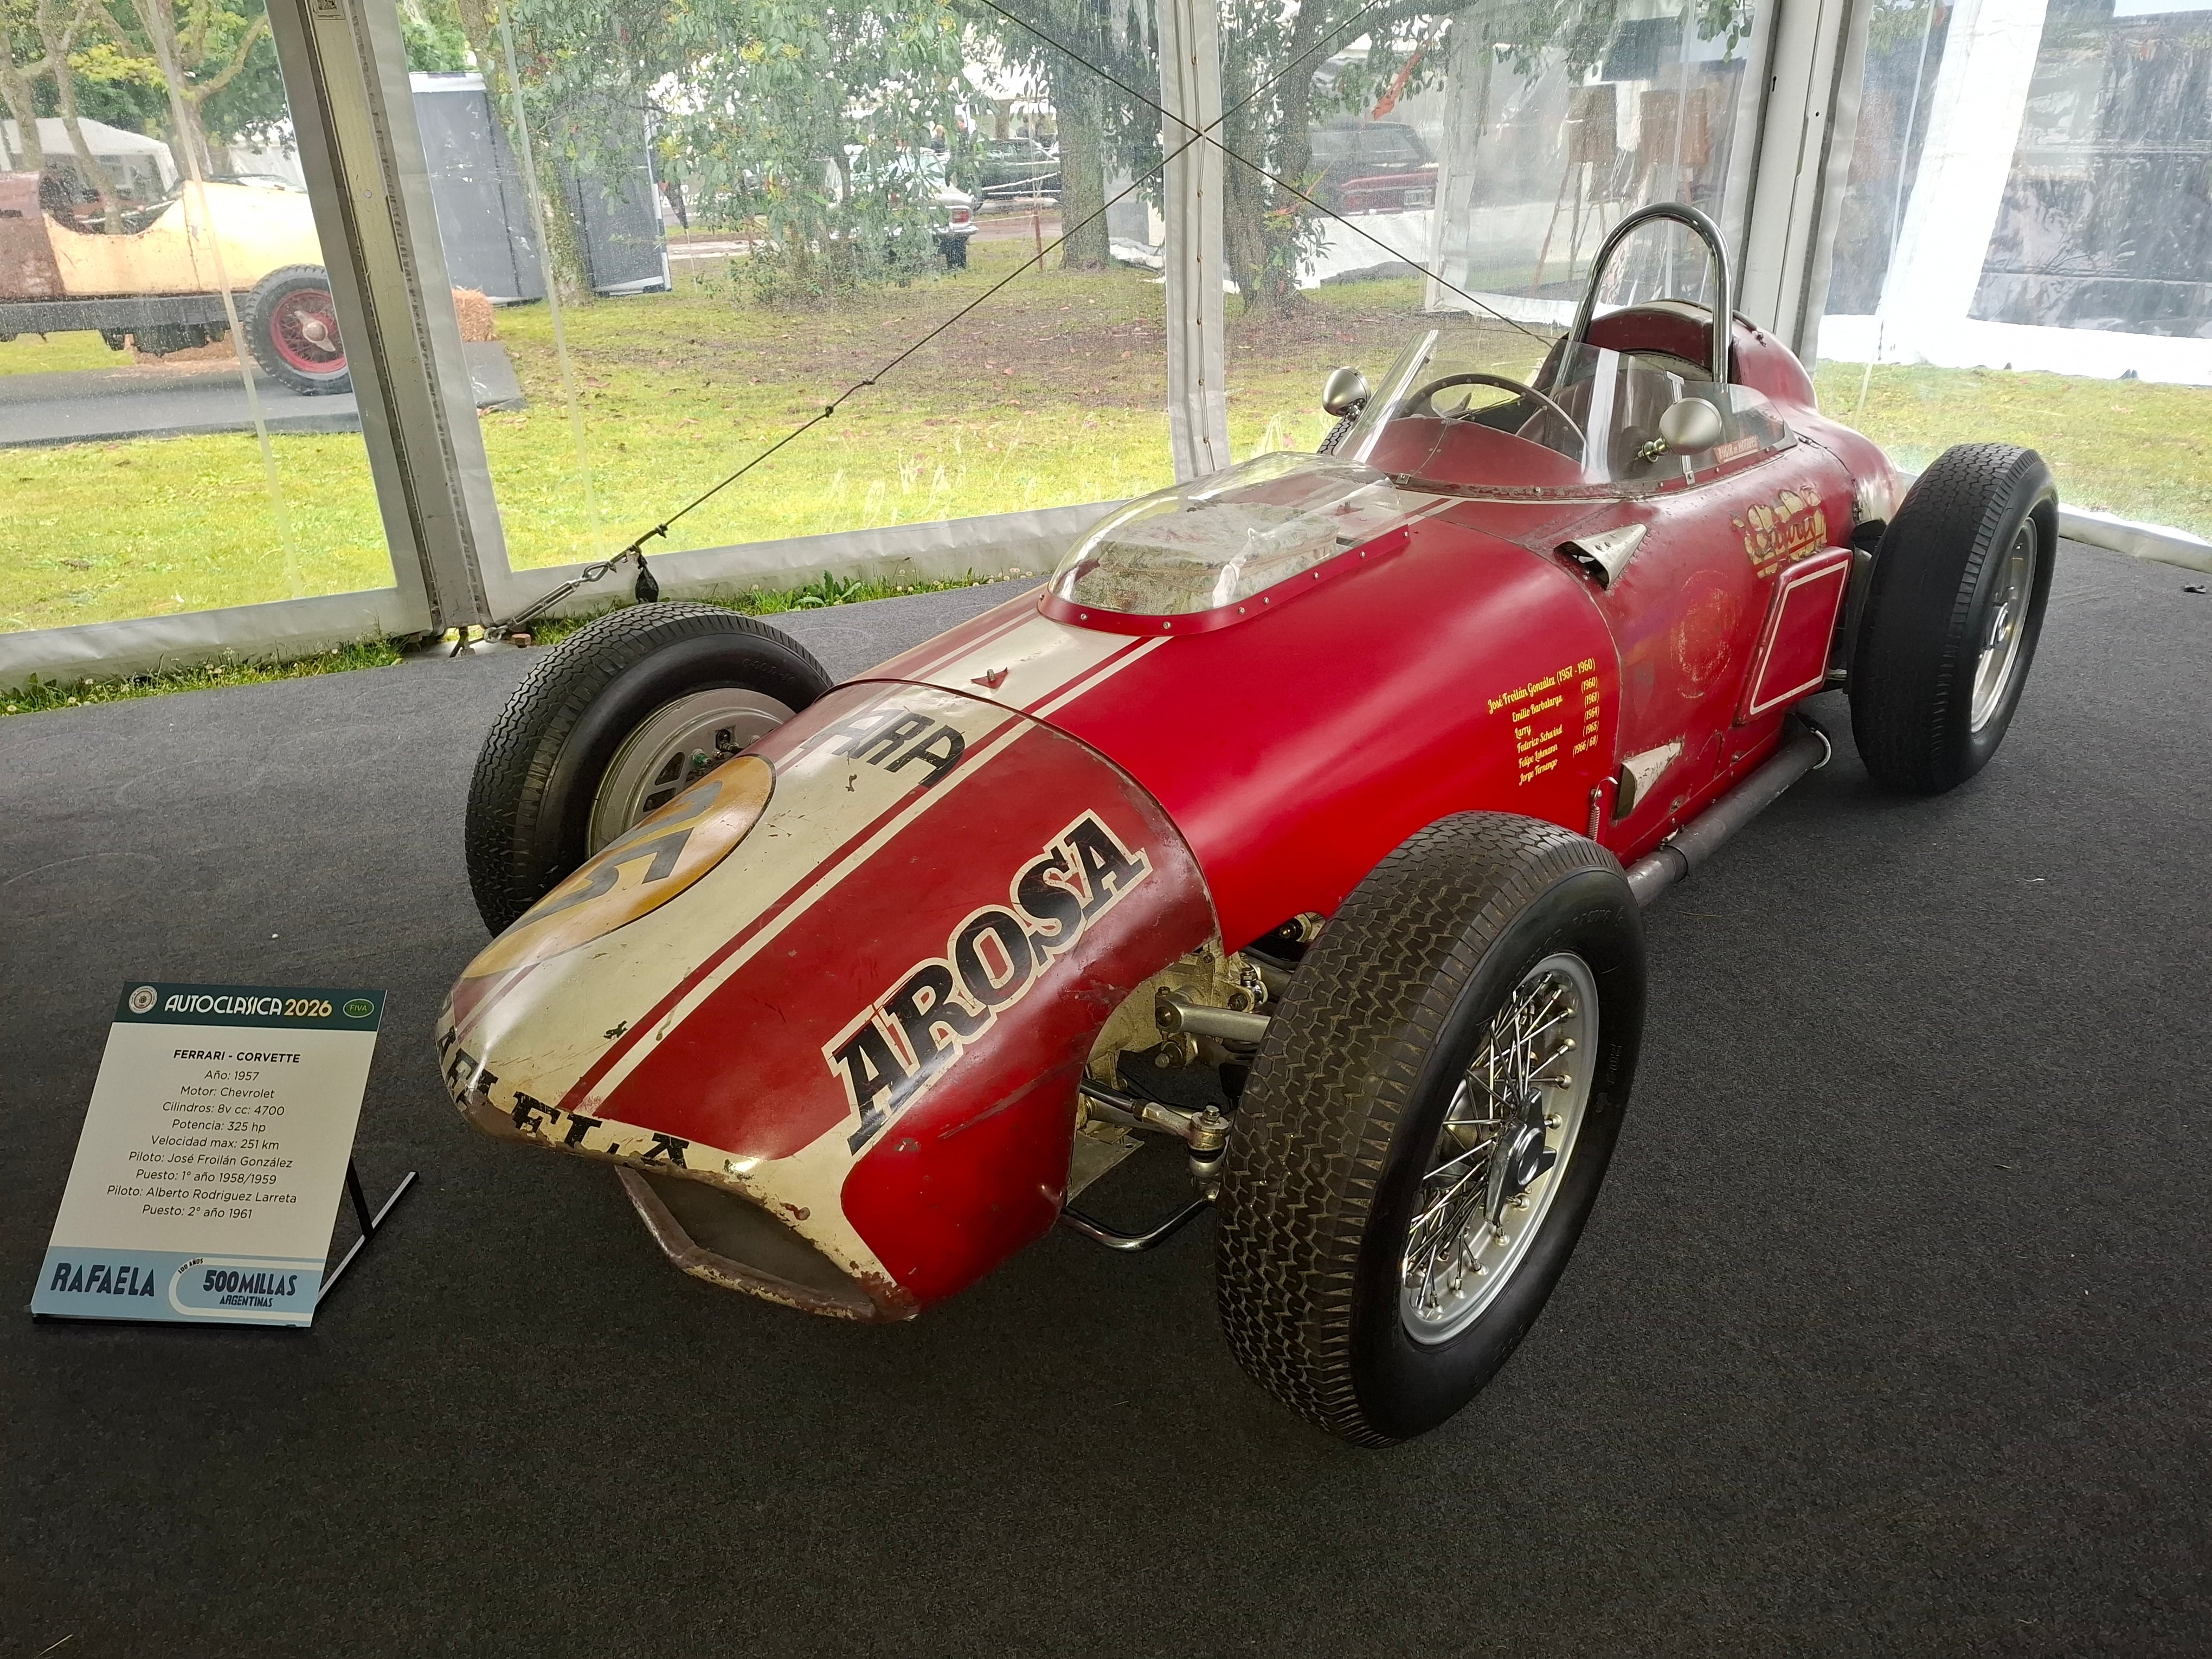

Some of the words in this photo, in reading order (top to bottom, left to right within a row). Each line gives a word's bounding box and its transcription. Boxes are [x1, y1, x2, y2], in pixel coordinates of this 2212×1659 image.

[1488, 695, 1503, 715] José
[1502, 686, 1528, 705] Froilán
[1527, 676, 1555, 697] González
[1557, 665, 1573, 686] (1957
[1577, 657, 1596, 674] 1960)
[1512, 708, 1531, 722] Emilio
[1530, 695, 1563, 715] Barbalarga
[1581, 676, 1598, 694] (1960)
[1514, 725, 1532, 740] Larry
[1584, 690, 1599, 709] (1961)
[1517, 737, 1540, 754] Federico
[1540, 724, 1562, 743] Schwind
[1584, 705, 1600, 723] (1964)
[1518, 755, 1534, 769] Felipe
[1534, 744, 1558, 762] Lehmann
[1519, 770, 1534, 786] Jorge
[1534, 758, 1558, 776] Ternengo
[826, 812, 1149, 1159] AROSA
[283, 998, 333, 1017] 2026
[349, 1004, 368, 1012] FIVA
[173, 1049, 226, 1060] FERRARI
[236, 1052, 301, 1063] CORVETTE
[204, 1070, 231, 1080] Año:
[234, 1071, 260, 1081] 1957
[180, 1085, 217, 1096] Motor:
[220, 1087, 275, 1098] Chevrolet
[163, 1101, 215, 1113] Cilindros:
[217, 1103, 232, 1114] 8v
[235, 1107, 251, 1115] cc:
[254, 1105, 285, 1116] 4700
[172, 1118, 224, 1130] Potencia:
[227, 1121, 249, 1131] 325
[251, 1122, 266, 1134] hp
[152, 1135, 208, 1147] Velocidad
[210, 1140, 237, 1148] max:
[240, 1139, 259, 1149] 251
[261, 1139, 279, 1150] km
[128, 1151, 165, 1162] Piloto:
[167, 1153, 194, 1163] José
[197, 1154, 236, 1166] Froilán
[240, 1156, 293, 1168] González
[136, 1168, 178, 1180] Puesto:
[194, 1172, 215, 1182] año
[219, 1172, 276, 1185] 1958/1959
[107, 1185, 143, 1197] Piloto:
[145, 1186, 189, 1198] Alberto
[255, 1192, 297, 1204] Larreta
[142, 1204, 185, 1216] Puesto:
[203, 1207, 225, 1218] año
[229, 1208, 252, 1219] 1961
[177, 1263, 188, 1275] 100
[50, 1262, 155, 1297] RAFAELA
[219, 1294, 273, 1308] ARGENTINAS
